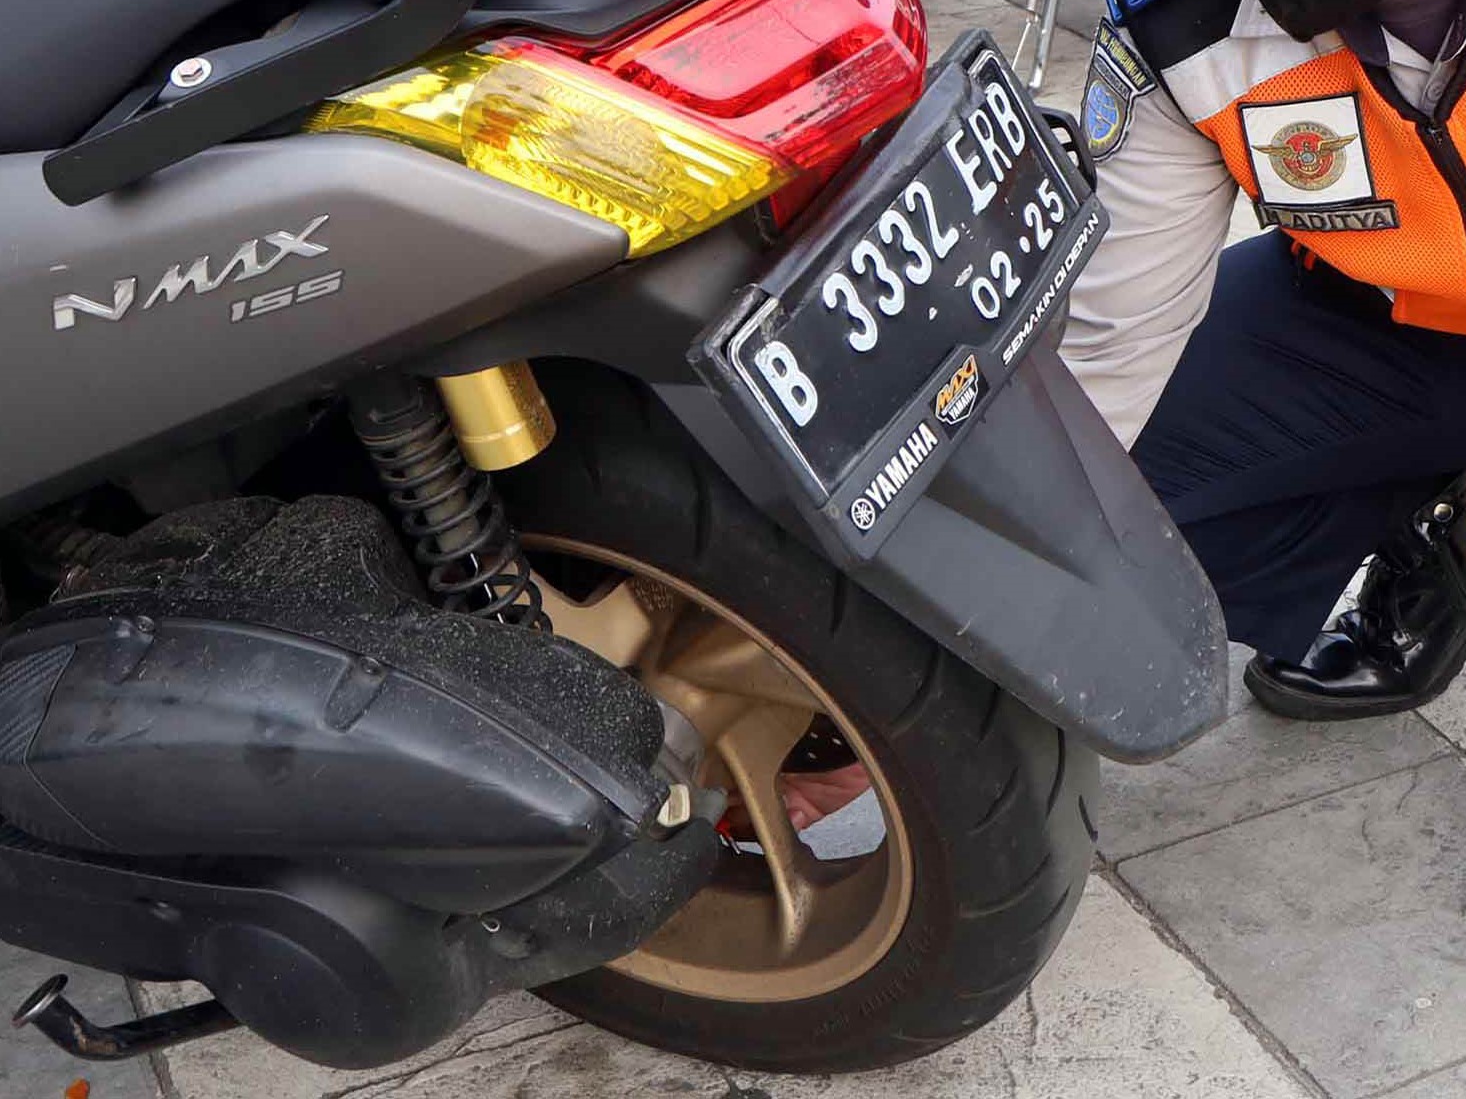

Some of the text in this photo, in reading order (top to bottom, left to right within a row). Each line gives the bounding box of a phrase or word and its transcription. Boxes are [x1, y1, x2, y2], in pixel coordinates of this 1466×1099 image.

[754, 82, 1027, 429] B 3332 ERB
[1290, 211, 1388, 229] ADITYA
[229, 269, 345, 323] 155
[1002, 212, 1100, 366] SEMAKIN DI DEPAN
[948, 386, 976, 420] YAMAHA
[866, 419, 938, 512] YAMAHA
